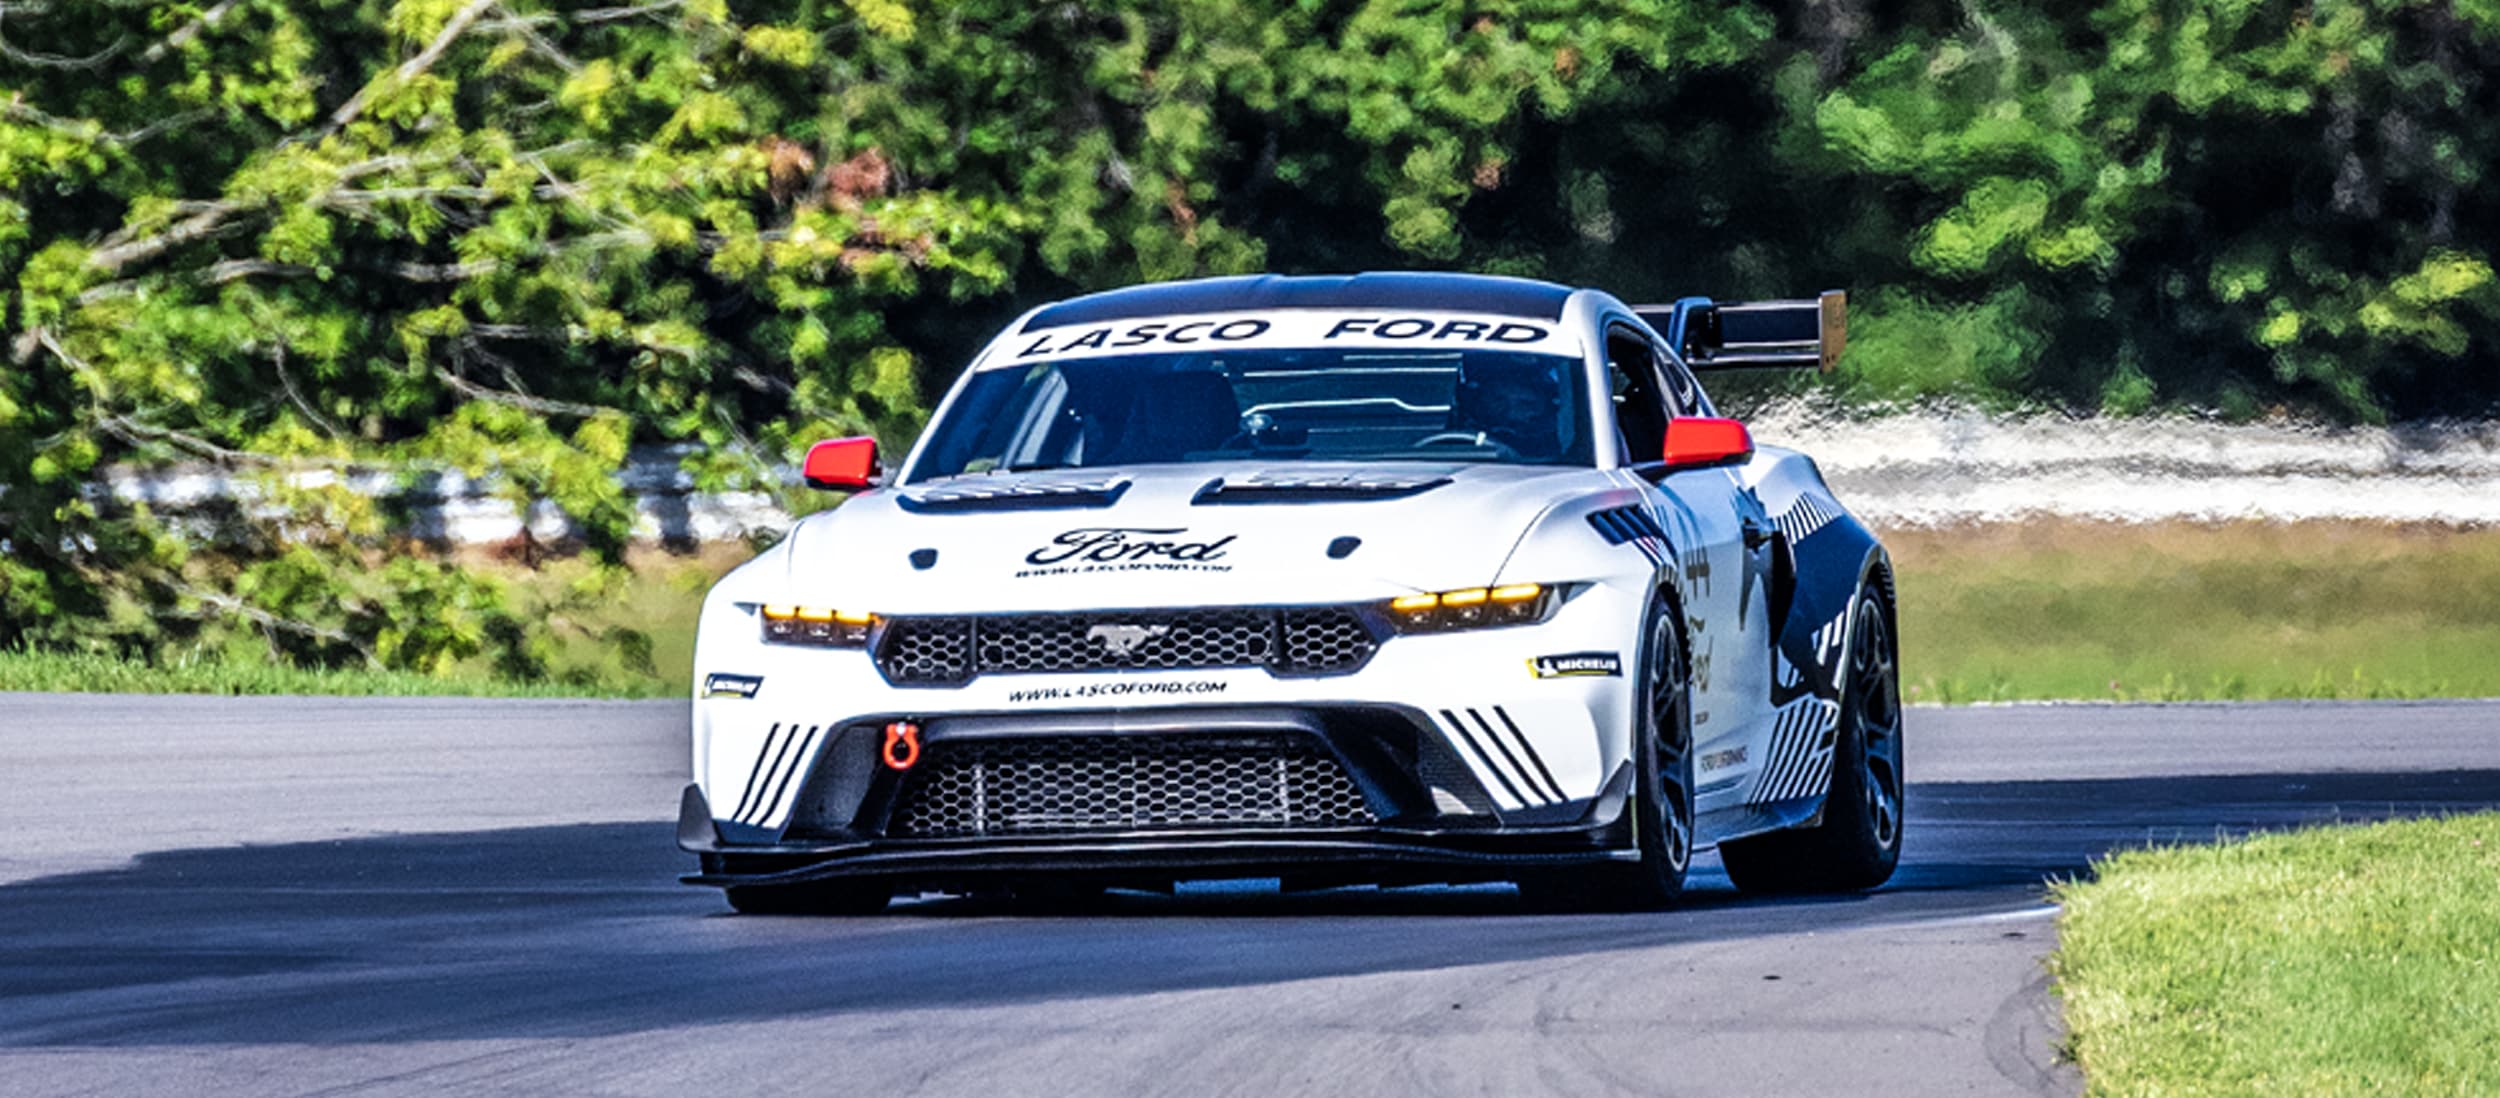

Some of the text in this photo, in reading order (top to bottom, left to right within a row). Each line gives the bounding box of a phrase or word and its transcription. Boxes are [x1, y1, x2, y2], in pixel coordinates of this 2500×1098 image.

[1017, 318, 1548, 358] LASCO FORD
[1024, 527, 1238, 565] Ford
[1008, 681, 1228, 702] WWW.LASCOFORD.COM
